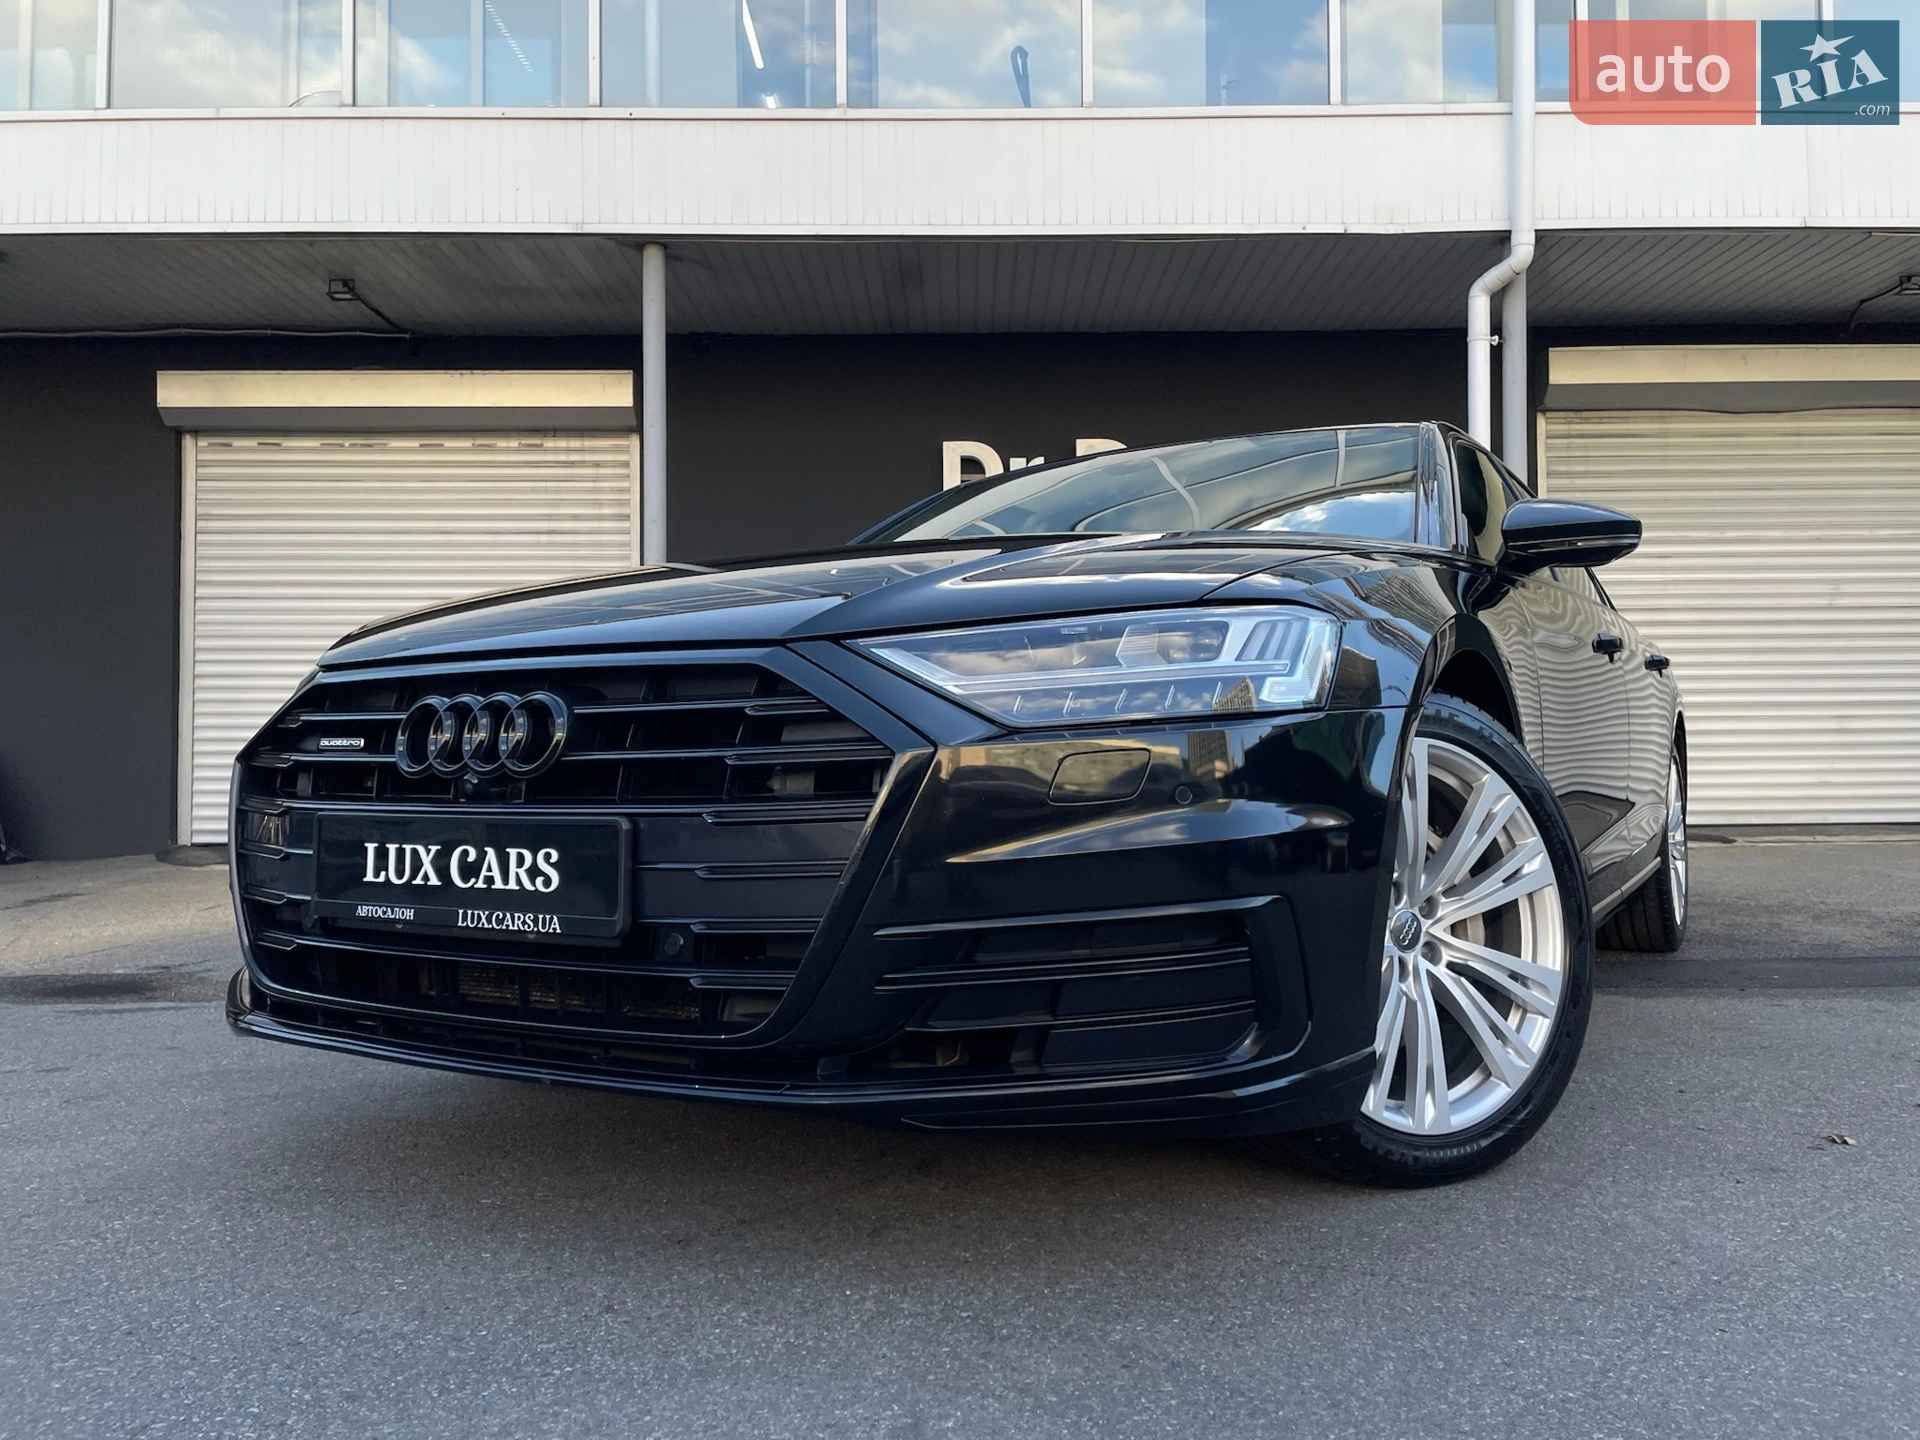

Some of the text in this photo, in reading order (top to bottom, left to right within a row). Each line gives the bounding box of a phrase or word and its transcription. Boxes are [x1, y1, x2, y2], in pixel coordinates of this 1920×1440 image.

[363, 843, 560, 893] LUX CARS
[355, 905, 414, 920] АВТОСАЛОН
[457, 910, 562, 933] LUX.CARS.UA
